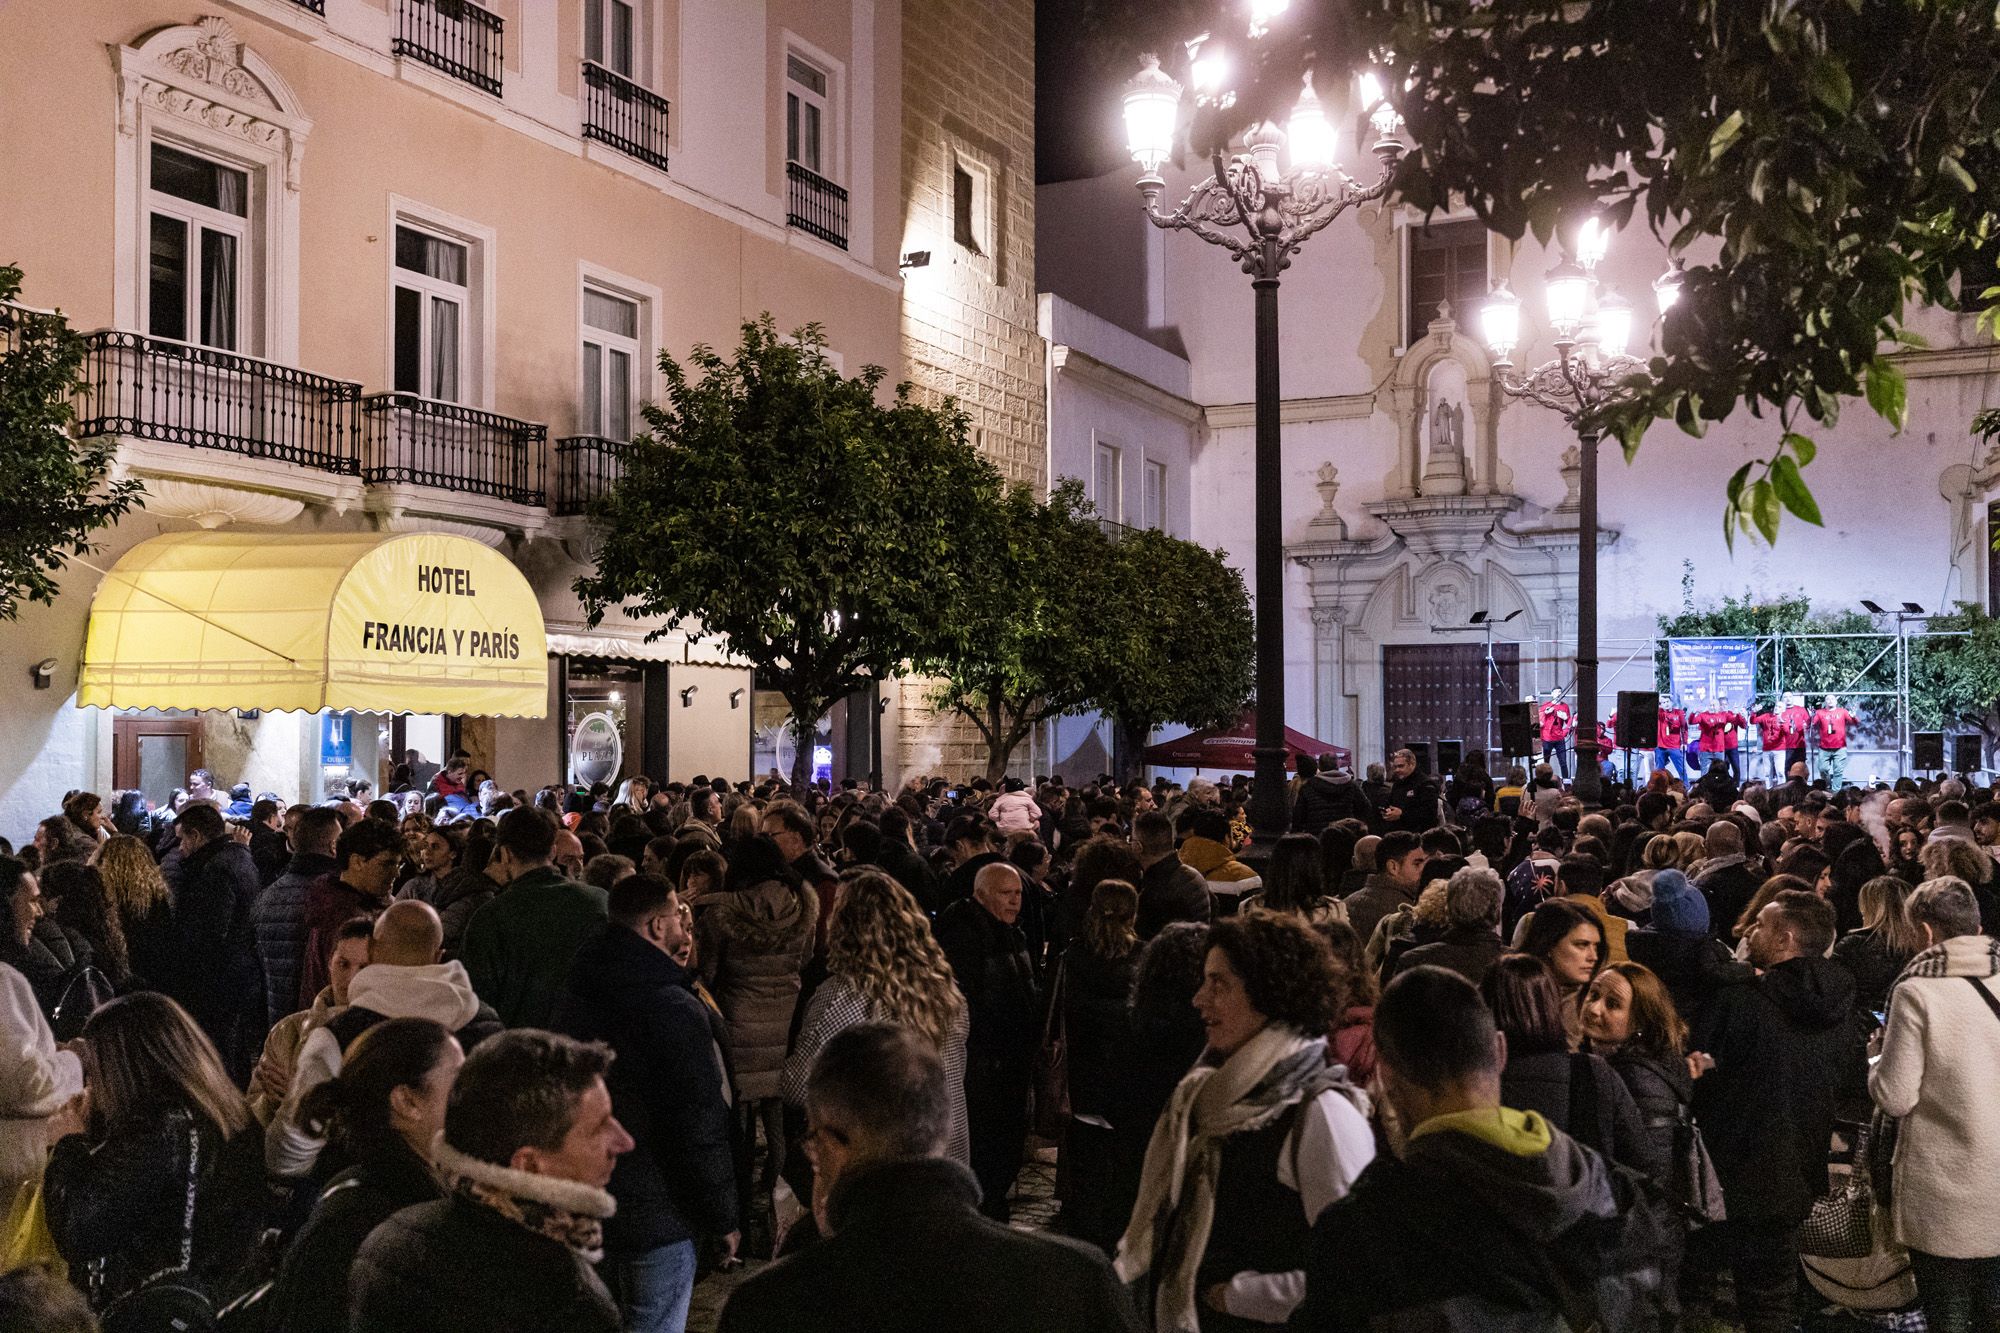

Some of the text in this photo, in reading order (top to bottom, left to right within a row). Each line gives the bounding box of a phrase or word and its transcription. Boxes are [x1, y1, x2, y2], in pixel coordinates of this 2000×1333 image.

[418, 564, 476, 597] HOTEL
[363, 621, 519, 660] FRANCIA Y PARÍS
[188, 1128, 200, 1174] MOUSE
[184, 1181, 196, 1229] MICKEY
